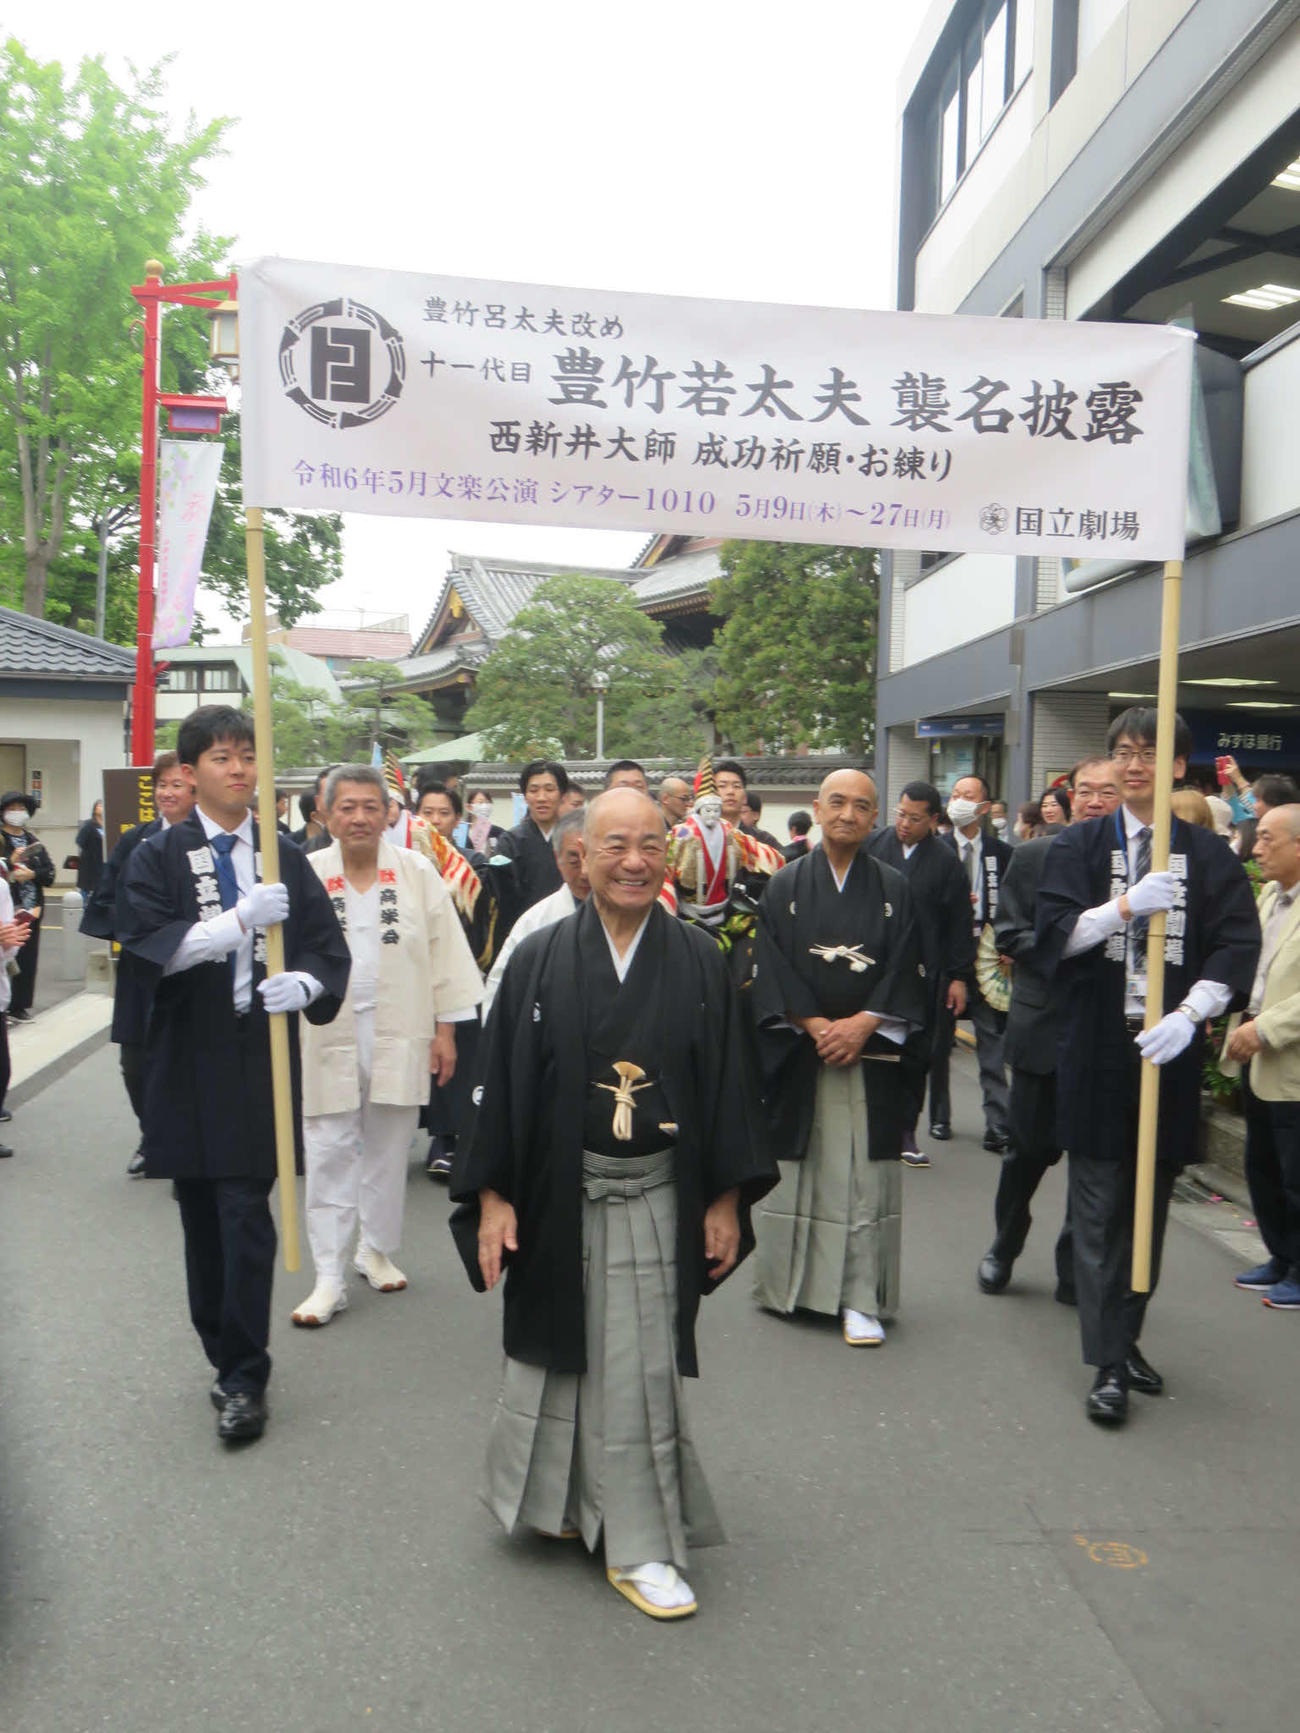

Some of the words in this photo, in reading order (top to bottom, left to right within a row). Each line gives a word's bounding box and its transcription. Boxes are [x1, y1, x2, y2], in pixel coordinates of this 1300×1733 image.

[422, 296, 624, 339] 豊竹呂太夫改め
[420, 350, 531, 384] 十一代目
[548, 346, 871, 426] 豊竹若太夫
[889, 371, 1145, 445] 襲名披露
[489, 420, 677, 465] 西新井大師
[292, 459, 538, 506] 令和6年5月文楽公演
[1015, 506, 1140, 542] 国立劇場
[1216, 732, 1283, 751] みずほ銀行
